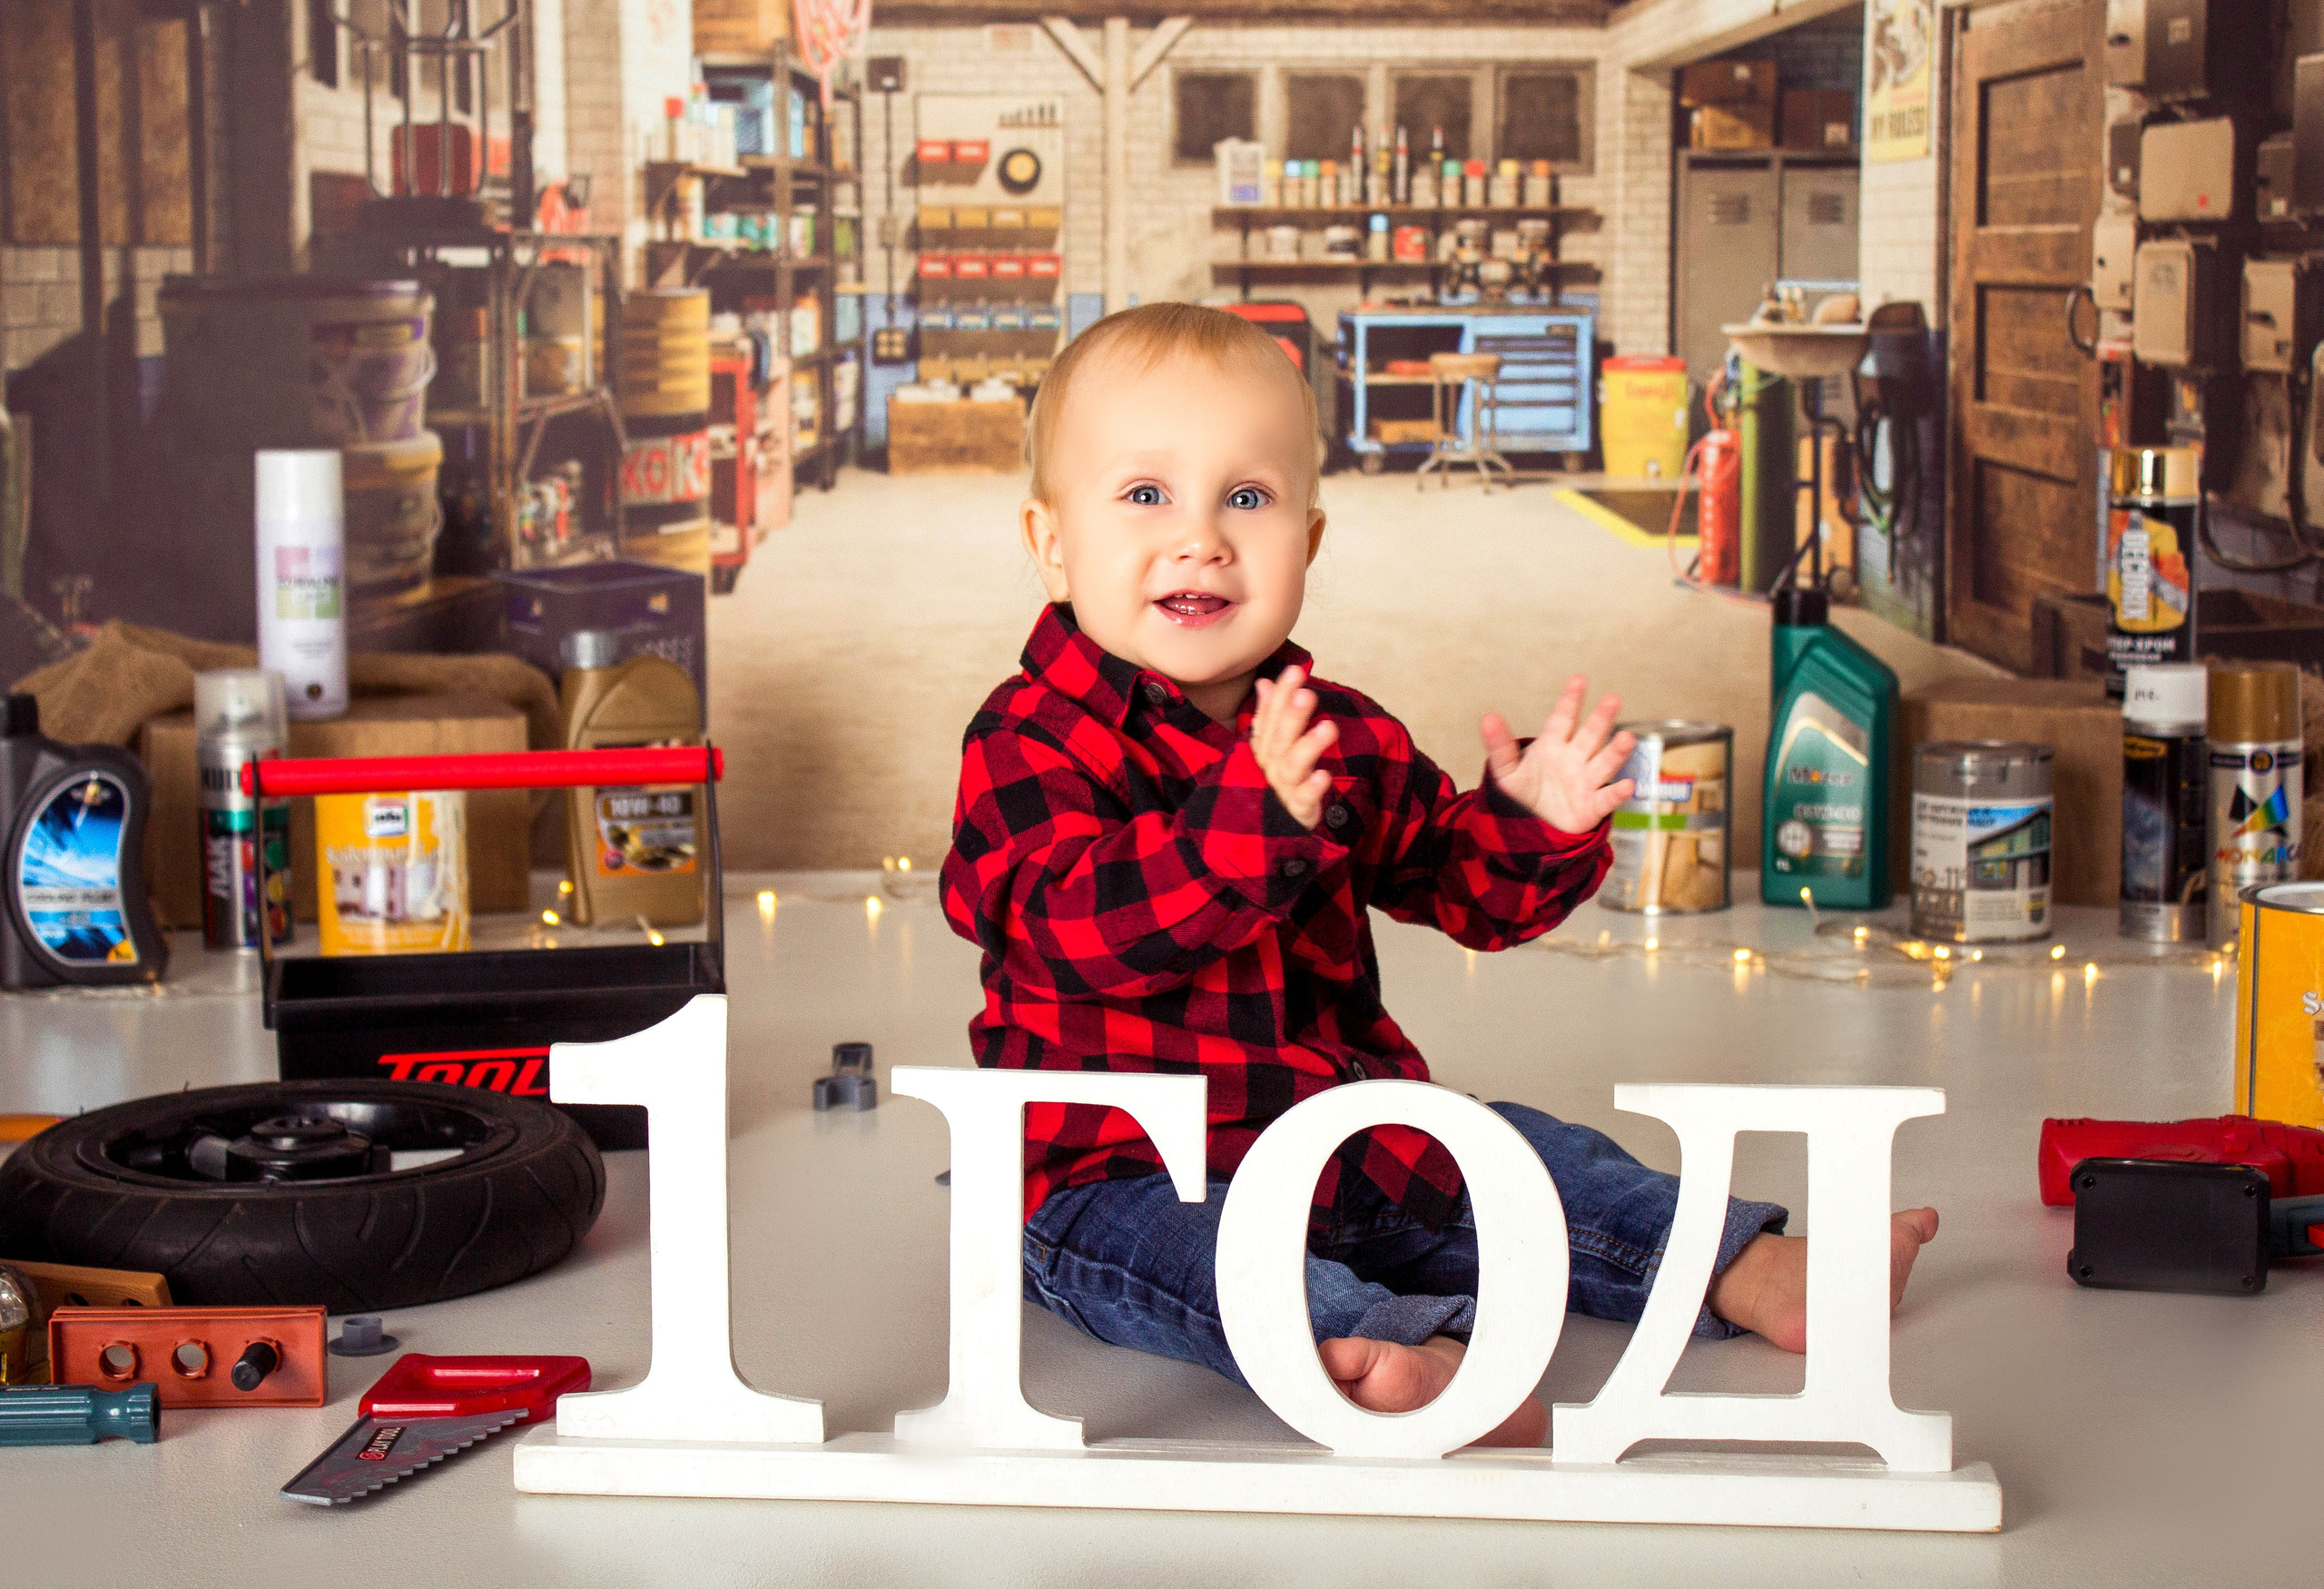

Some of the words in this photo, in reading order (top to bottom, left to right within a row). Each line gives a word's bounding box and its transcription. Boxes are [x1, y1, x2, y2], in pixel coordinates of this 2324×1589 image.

[549, 994, 825, 1444] 1
[376, 1426, 401, 1440] TOOL
[367, 1440, 391, 1453] PLAY
